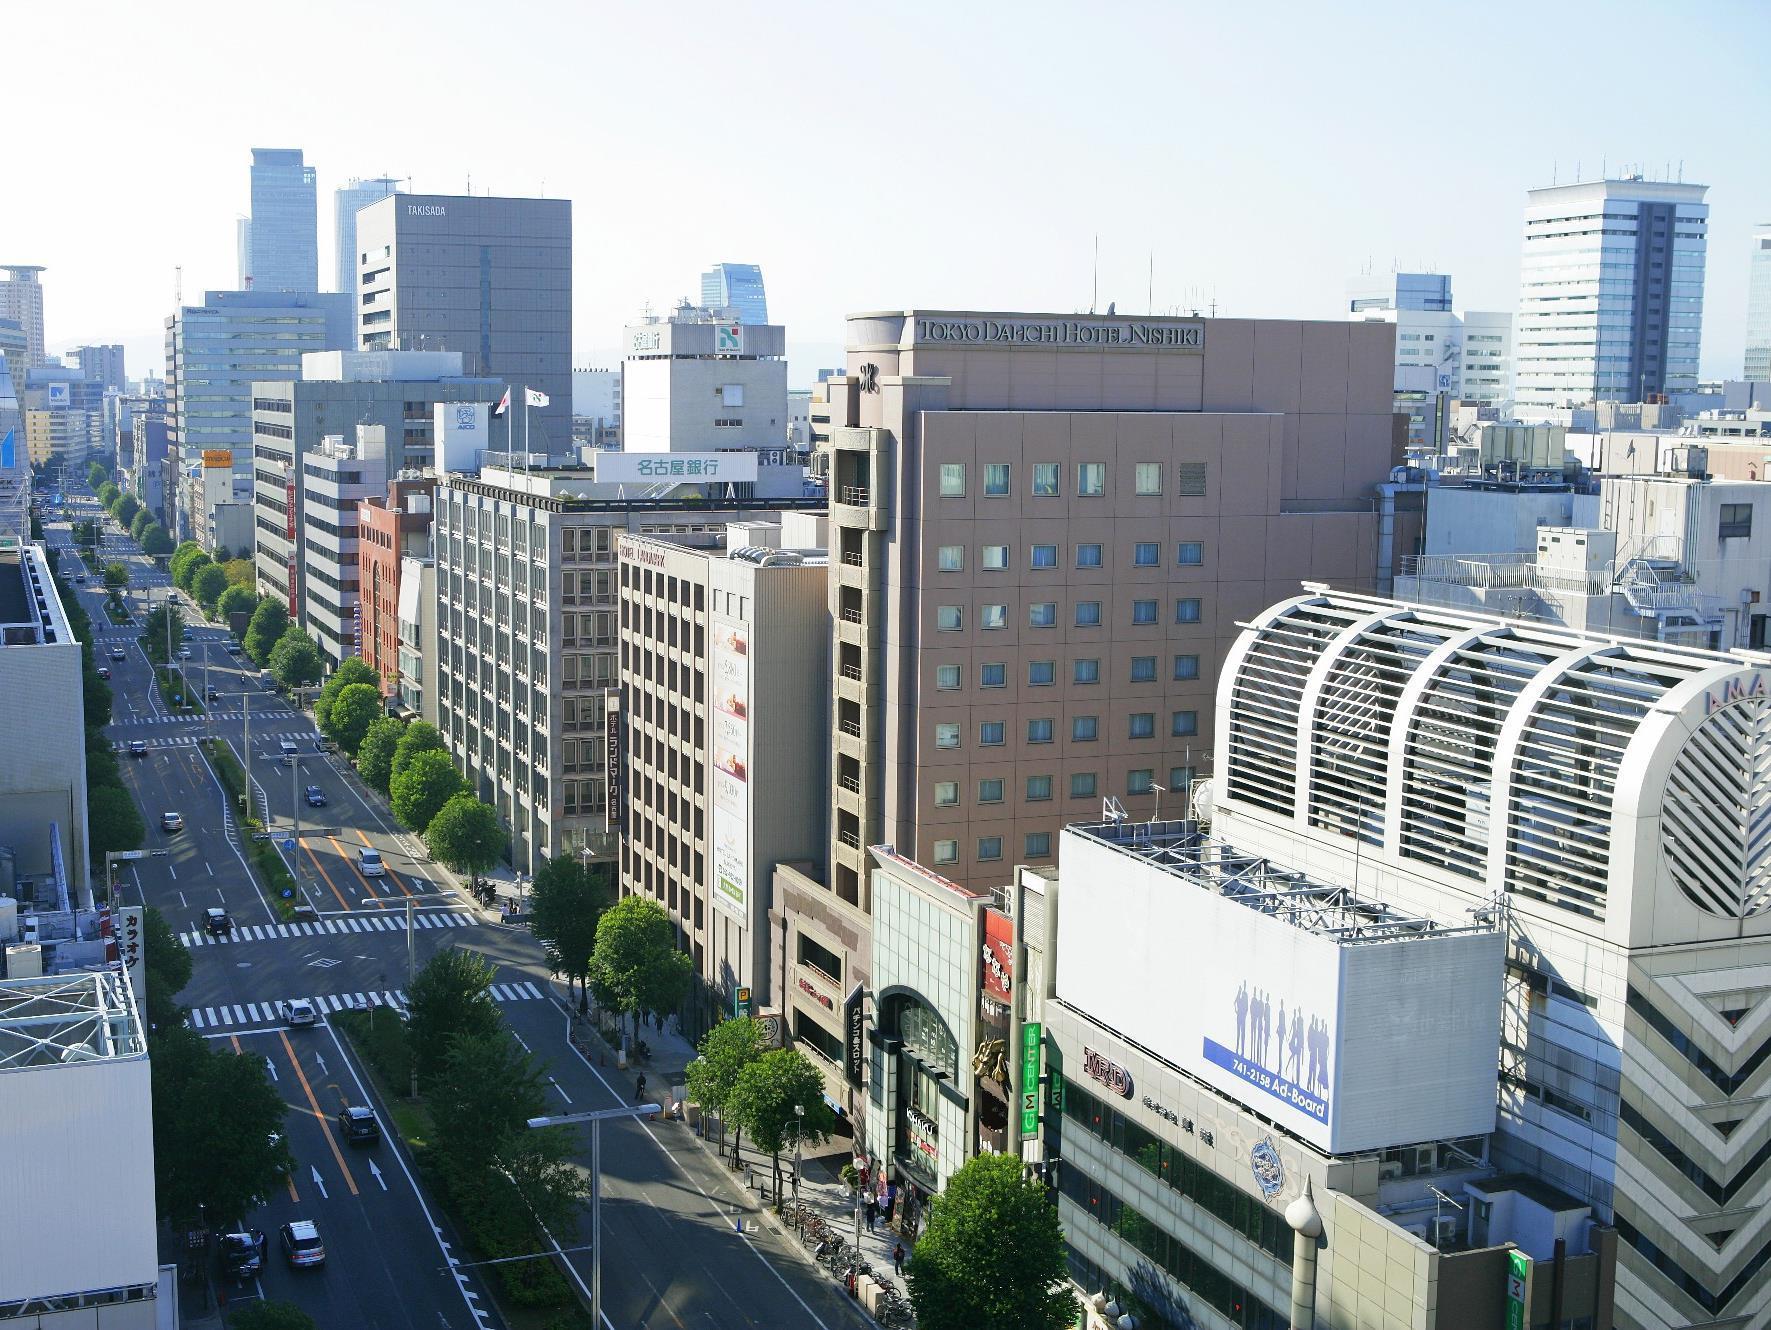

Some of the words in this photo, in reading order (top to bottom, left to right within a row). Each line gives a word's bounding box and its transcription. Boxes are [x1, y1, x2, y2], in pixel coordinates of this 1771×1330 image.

[408, 205, 446, 217] TAKISADA
[918, 320, 982, 341] TOKYO
[1063, 322, 1128, 344] HOTEL
[1127, 324, 1201, 346] NISHIKI
[637, 459, 719, 476] 名古屋銀行
[609, 736, 618, 796] ランドマーク
[126, 915, 140, 972] カラオケ
[1027, 1025, 1037, 1090] CENTER
[1232, 1059, 1271, 1089] 741-2158
[1271, 1079, 1325, 1118] Ad-Board
